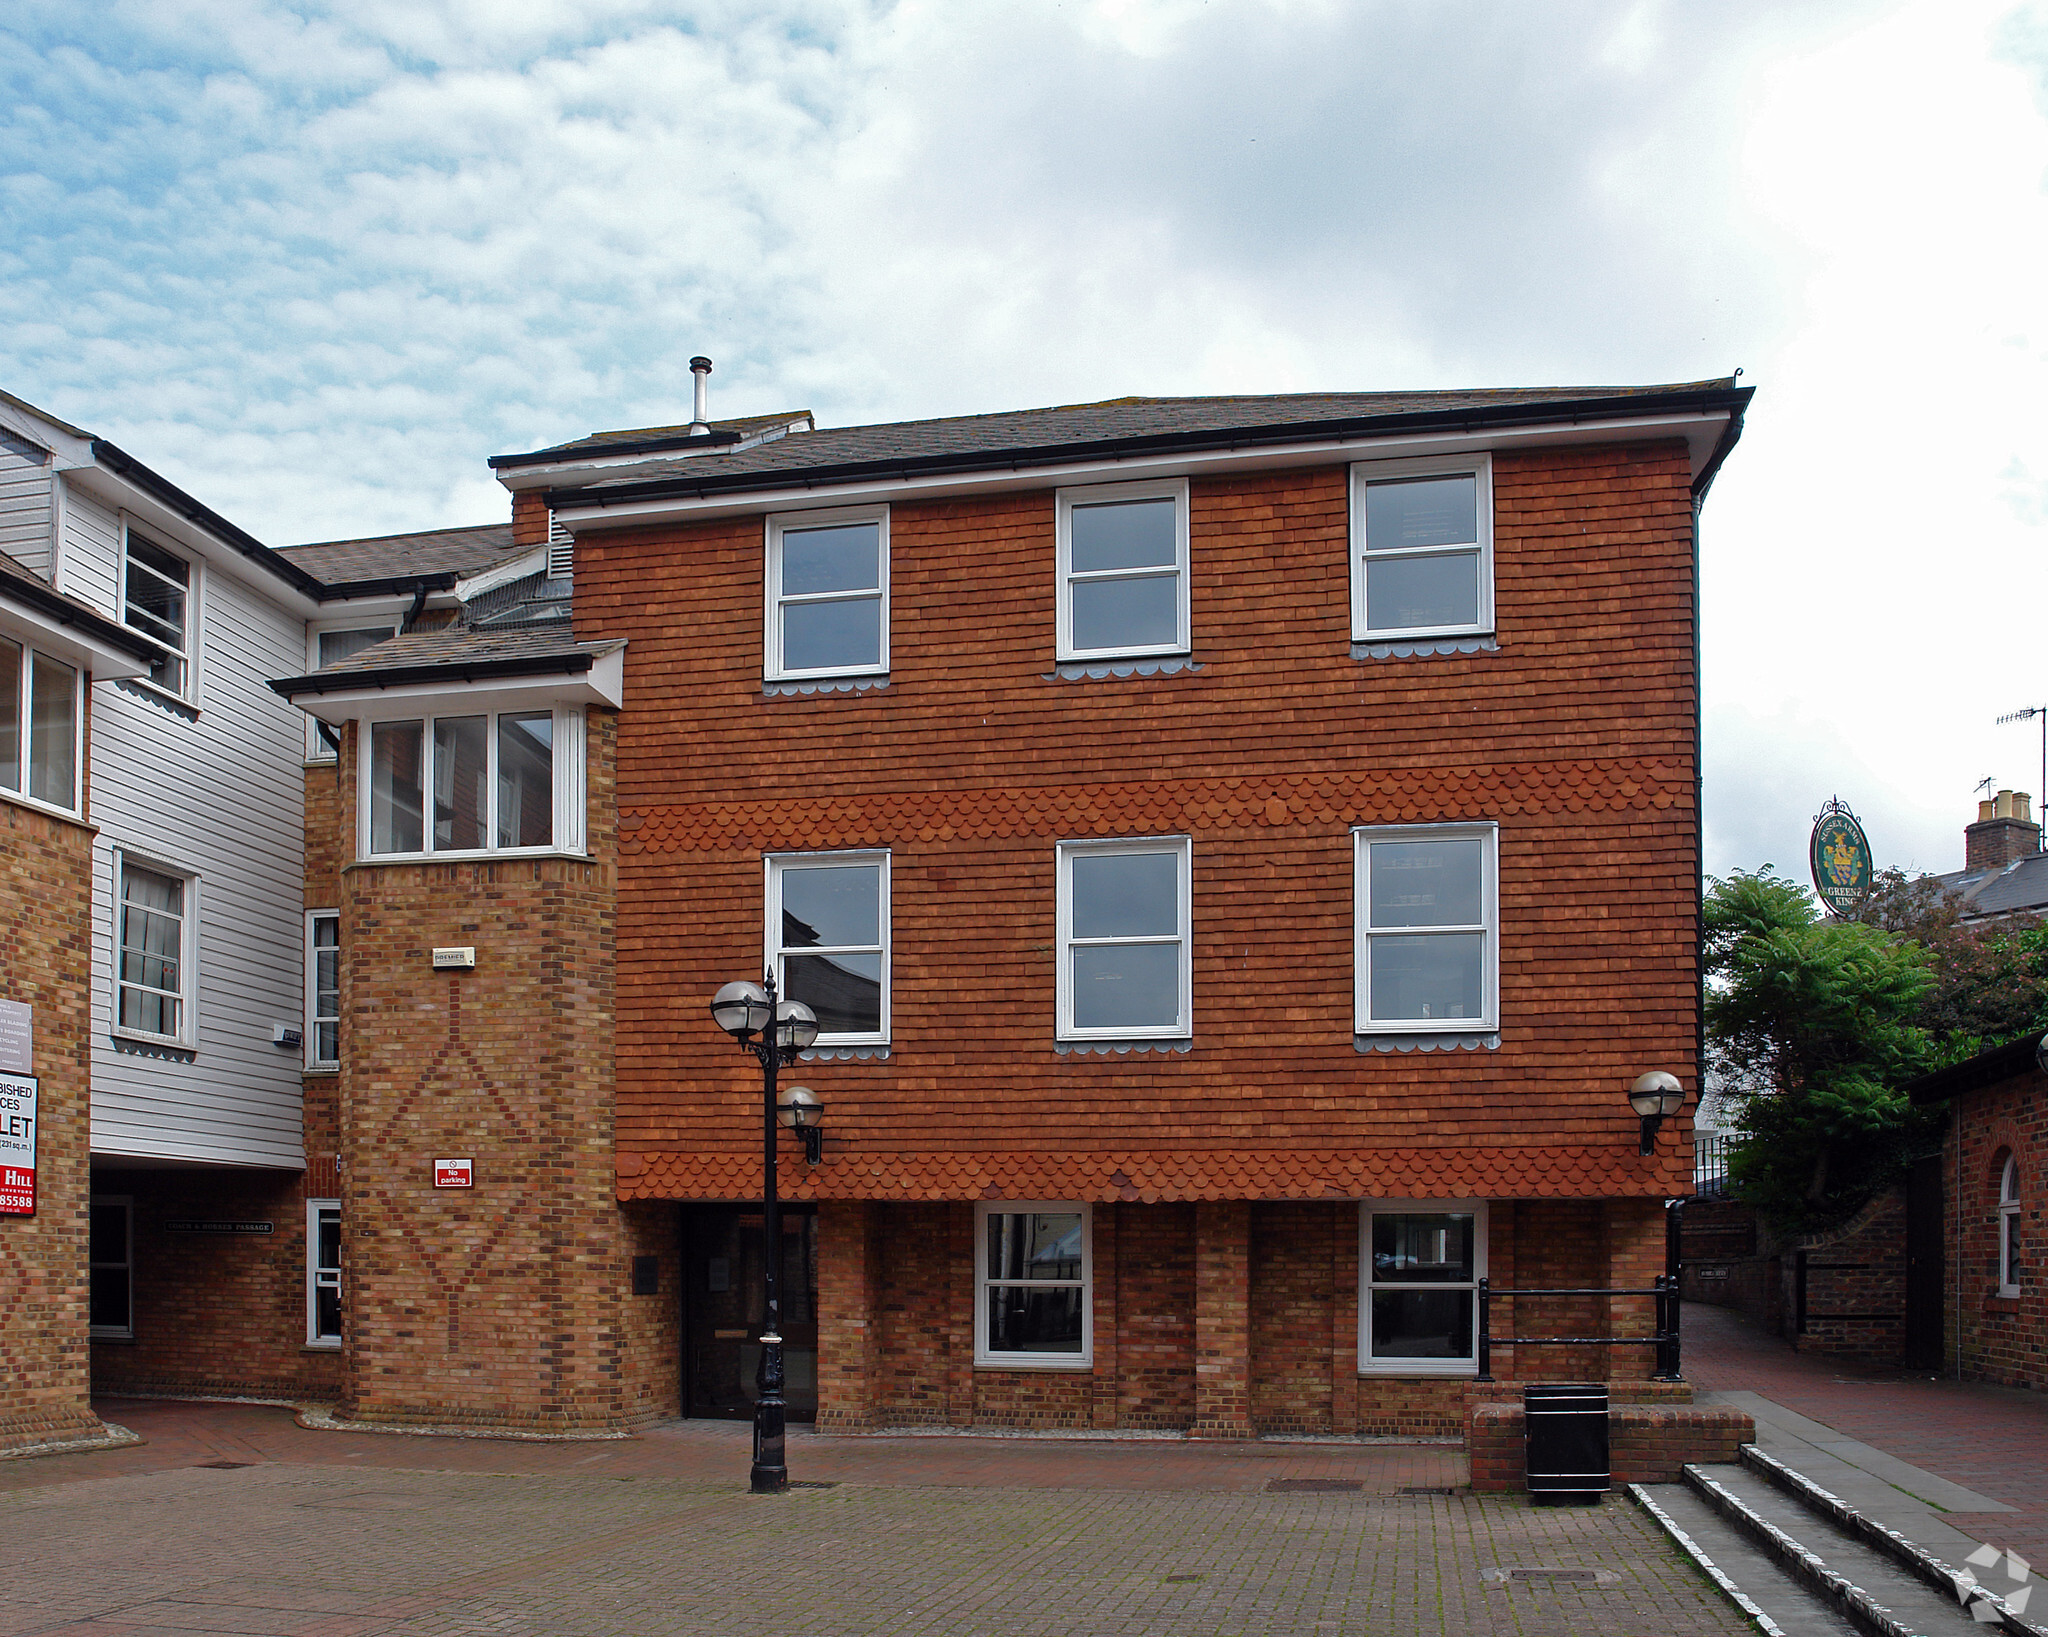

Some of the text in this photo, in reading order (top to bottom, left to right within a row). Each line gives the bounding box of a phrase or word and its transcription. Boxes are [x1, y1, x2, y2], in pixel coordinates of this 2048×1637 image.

[1821, 820, 1860, 845] SUSSEX ARMS
[0, 1113, 33, 1139] LET
[440, 1177, 466, 1185] parking
[0, 1194, 33, 1208] 85588
